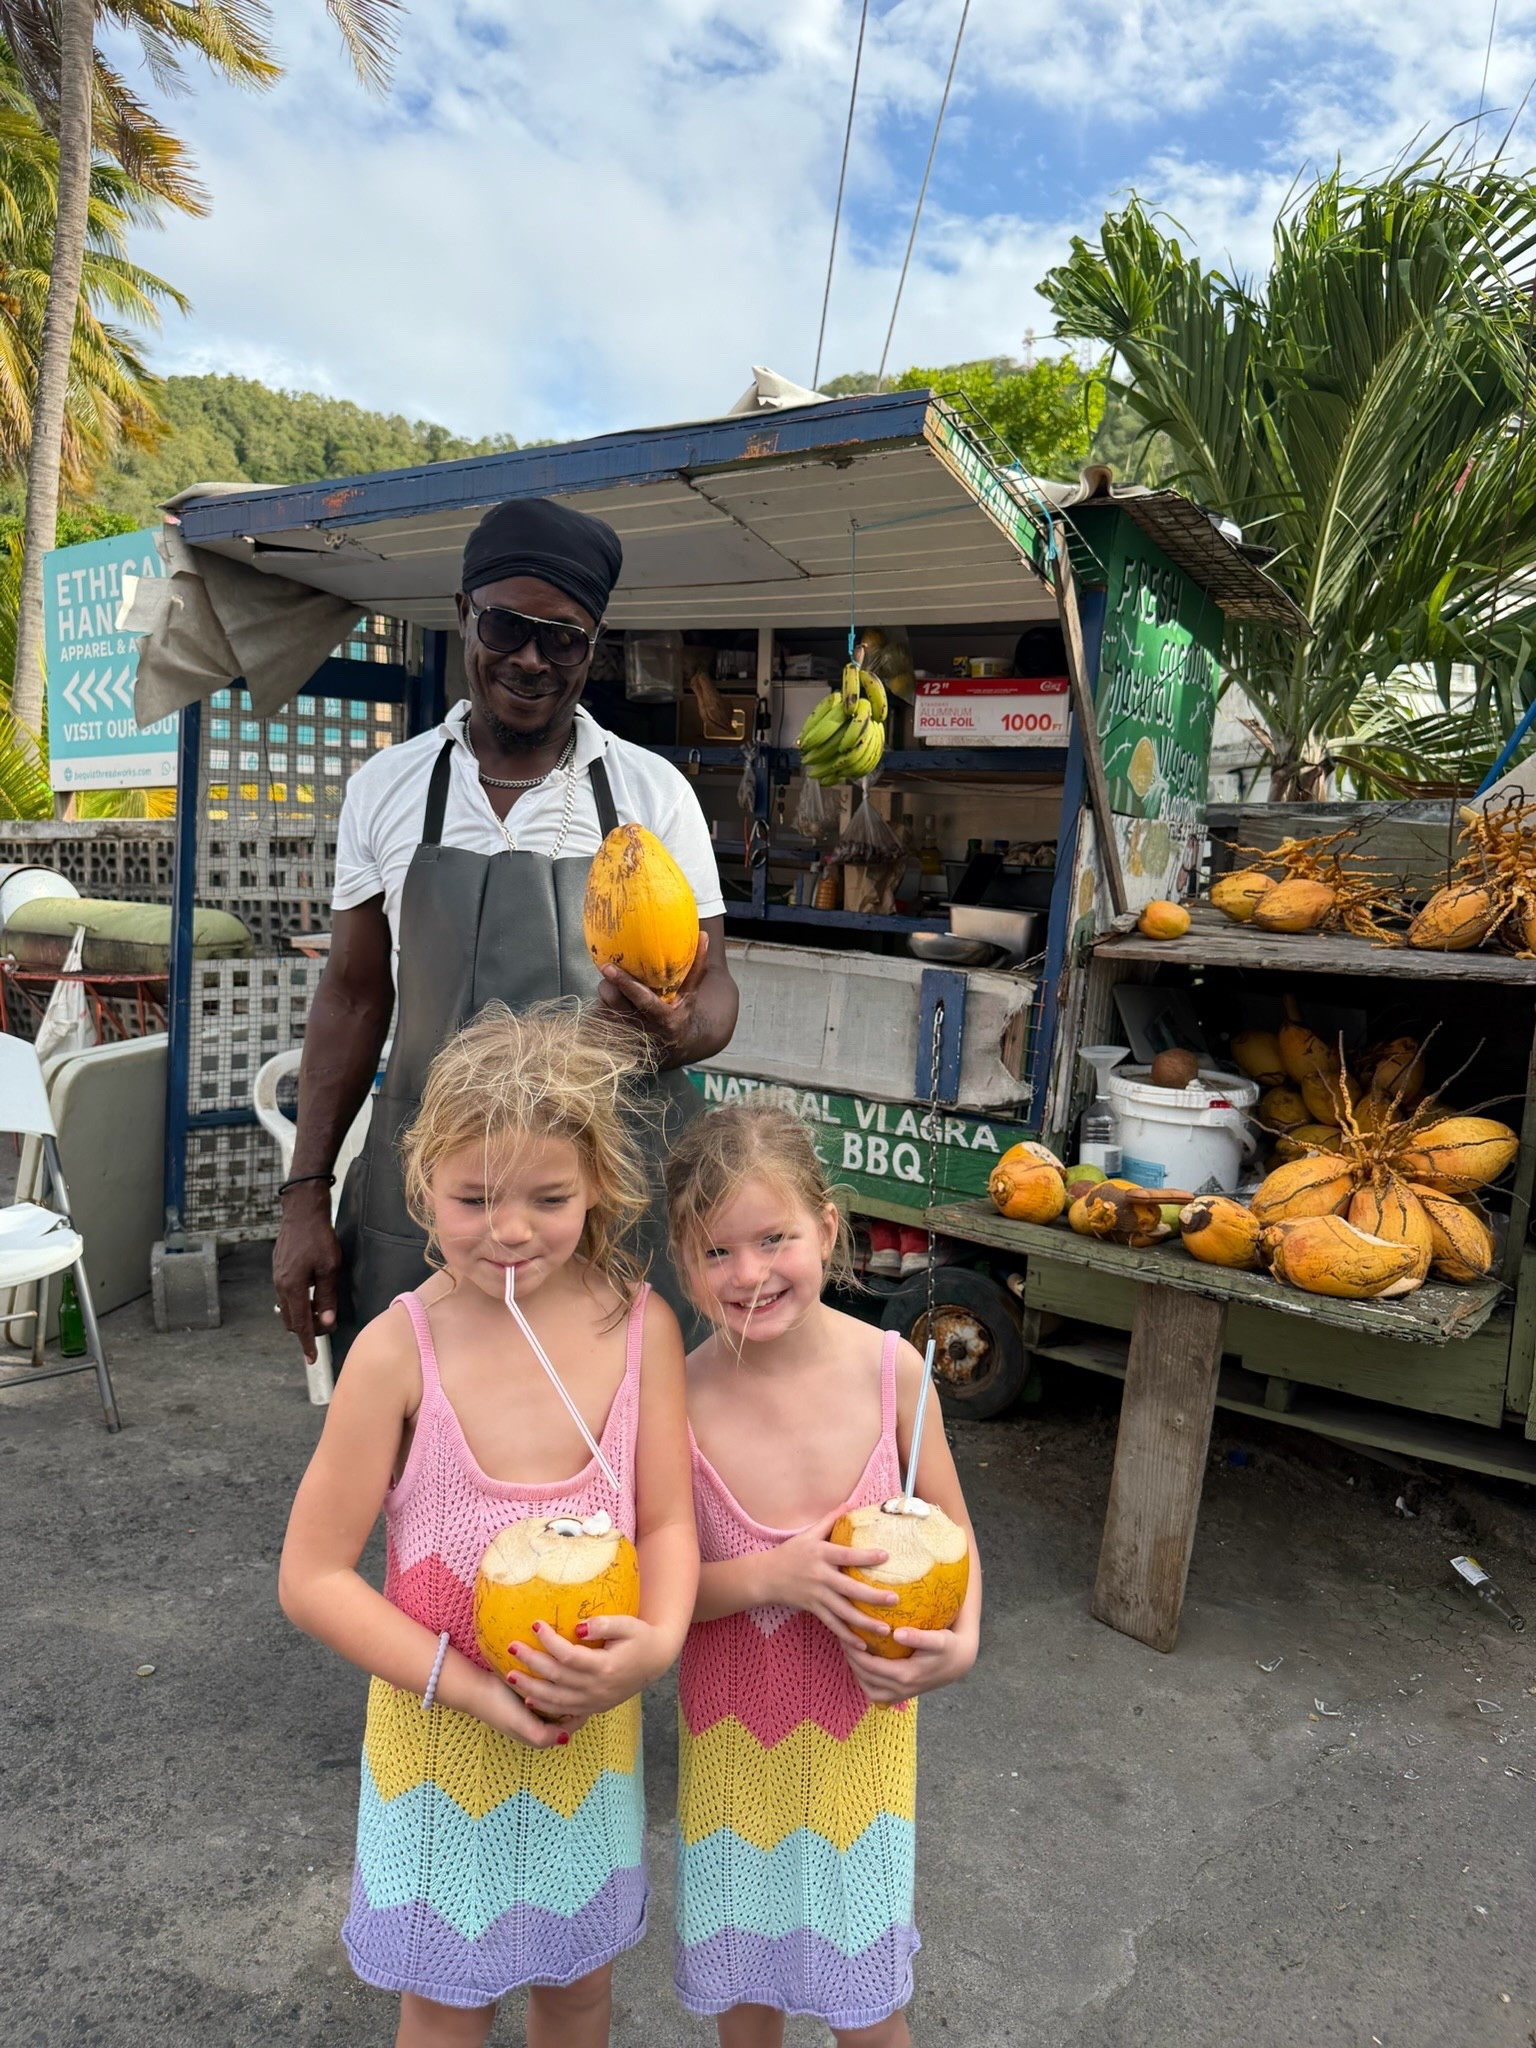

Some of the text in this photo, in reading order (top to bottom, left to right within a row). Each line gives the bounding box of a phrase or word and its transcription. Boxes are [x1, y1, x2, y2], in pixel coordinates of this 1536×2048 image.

[1116, 558, 1184, 632] FRESH
[58, 600, 125, 643] HAN
[60, 640, 114, 663] APPAREL
[116, 638, 126, 655] &
[922, 682, 950, 695] 12"
[920, 707, 973, 717] ALUMINUM
[920, 716, 975, 727] ROLL FOIL
[1001, 713, 1052, 731] 1000
[63, 720, 103, 743] VISIT
[106, 717, 138, 739] OUR
[841, 1130, 925, 1184] BBQ
